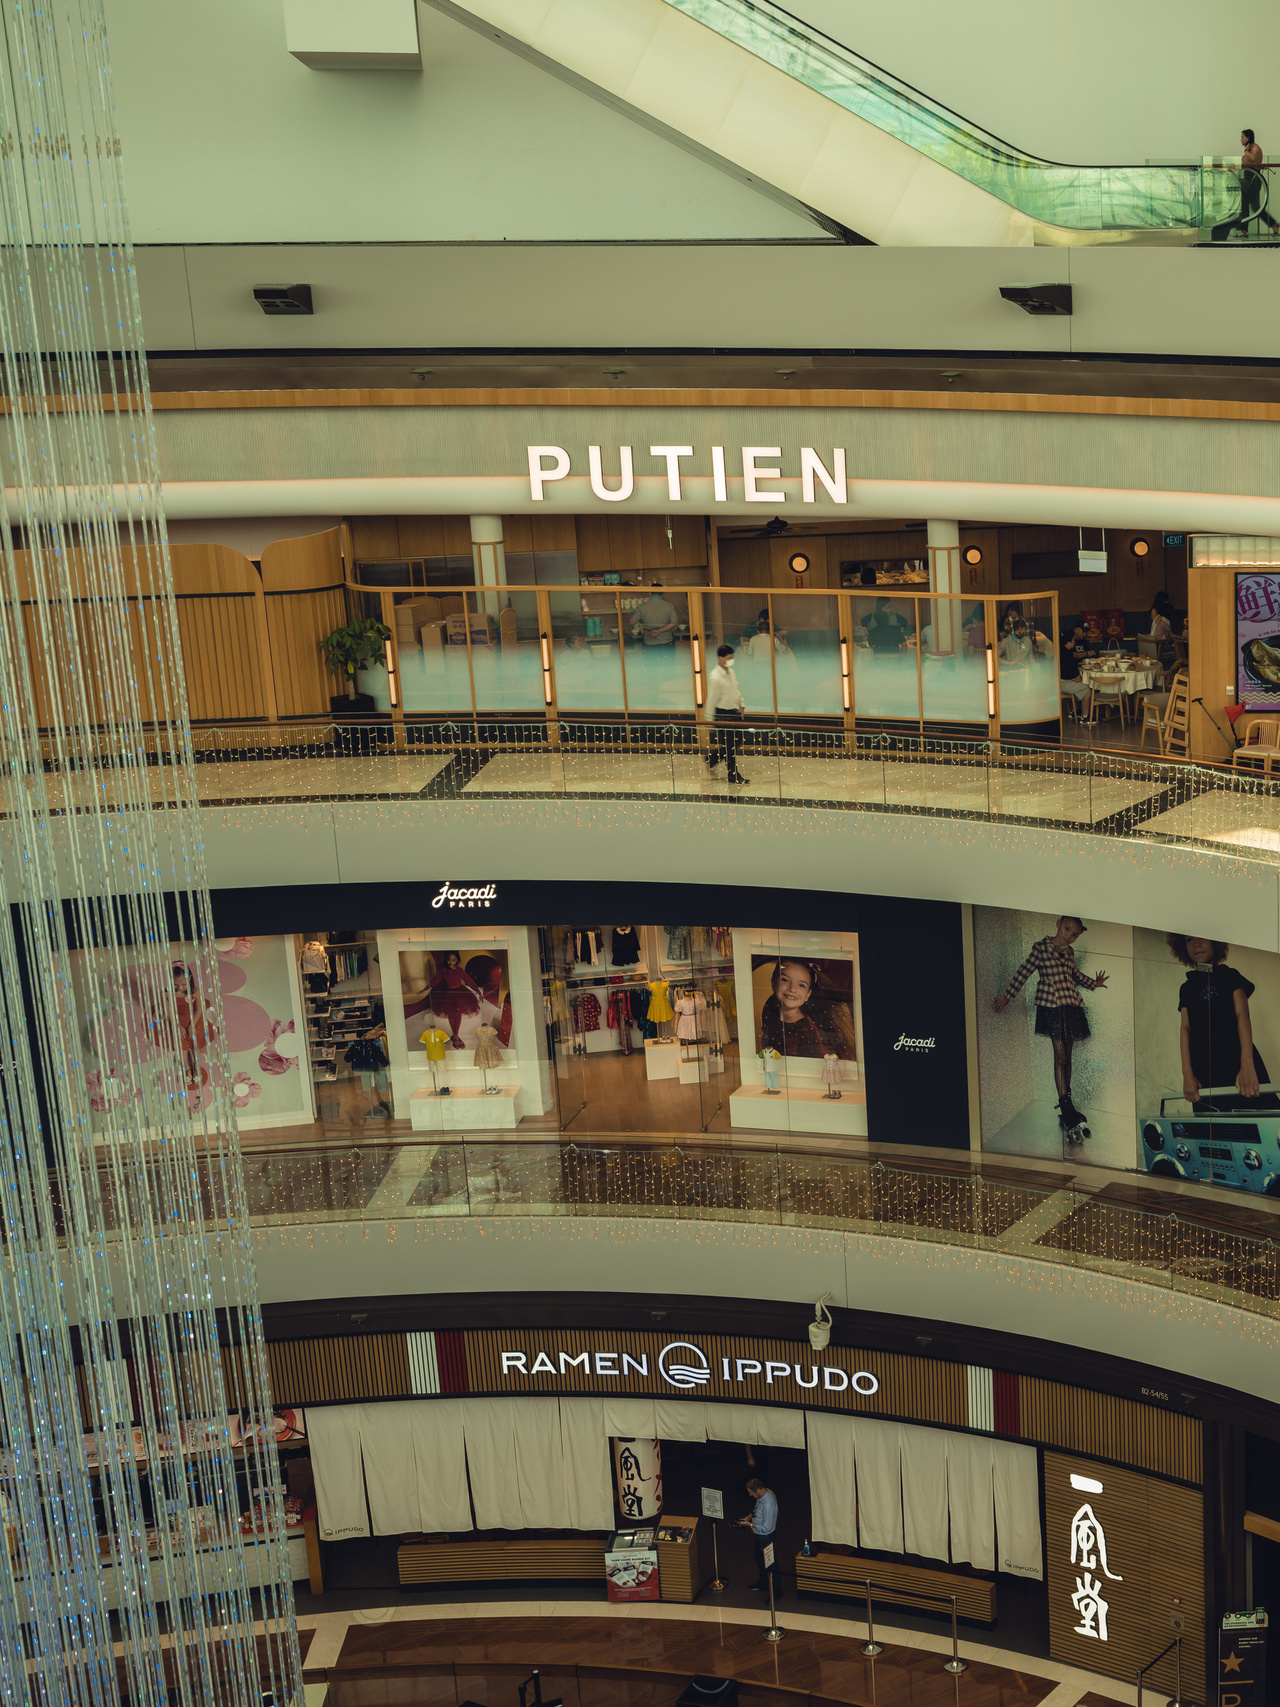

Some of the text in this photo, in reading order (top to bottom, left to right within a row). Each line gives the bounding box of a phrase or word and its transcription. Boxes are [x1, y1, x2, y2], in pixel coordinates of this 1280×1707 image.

[527, 445, 849, 504] PUTIEN
[1169, 535, 1184, 545] EXIT
[449, 900, 491, 908] PARIS
[501, 1352, 880, 1396] RAMEN IPPUDO
[1141, 1387, 1169, 1402] B2-54/55
[334, 1526, 364, 1535] IPPUDO
[1069, 1473, 1124, 1642] 一風堂
